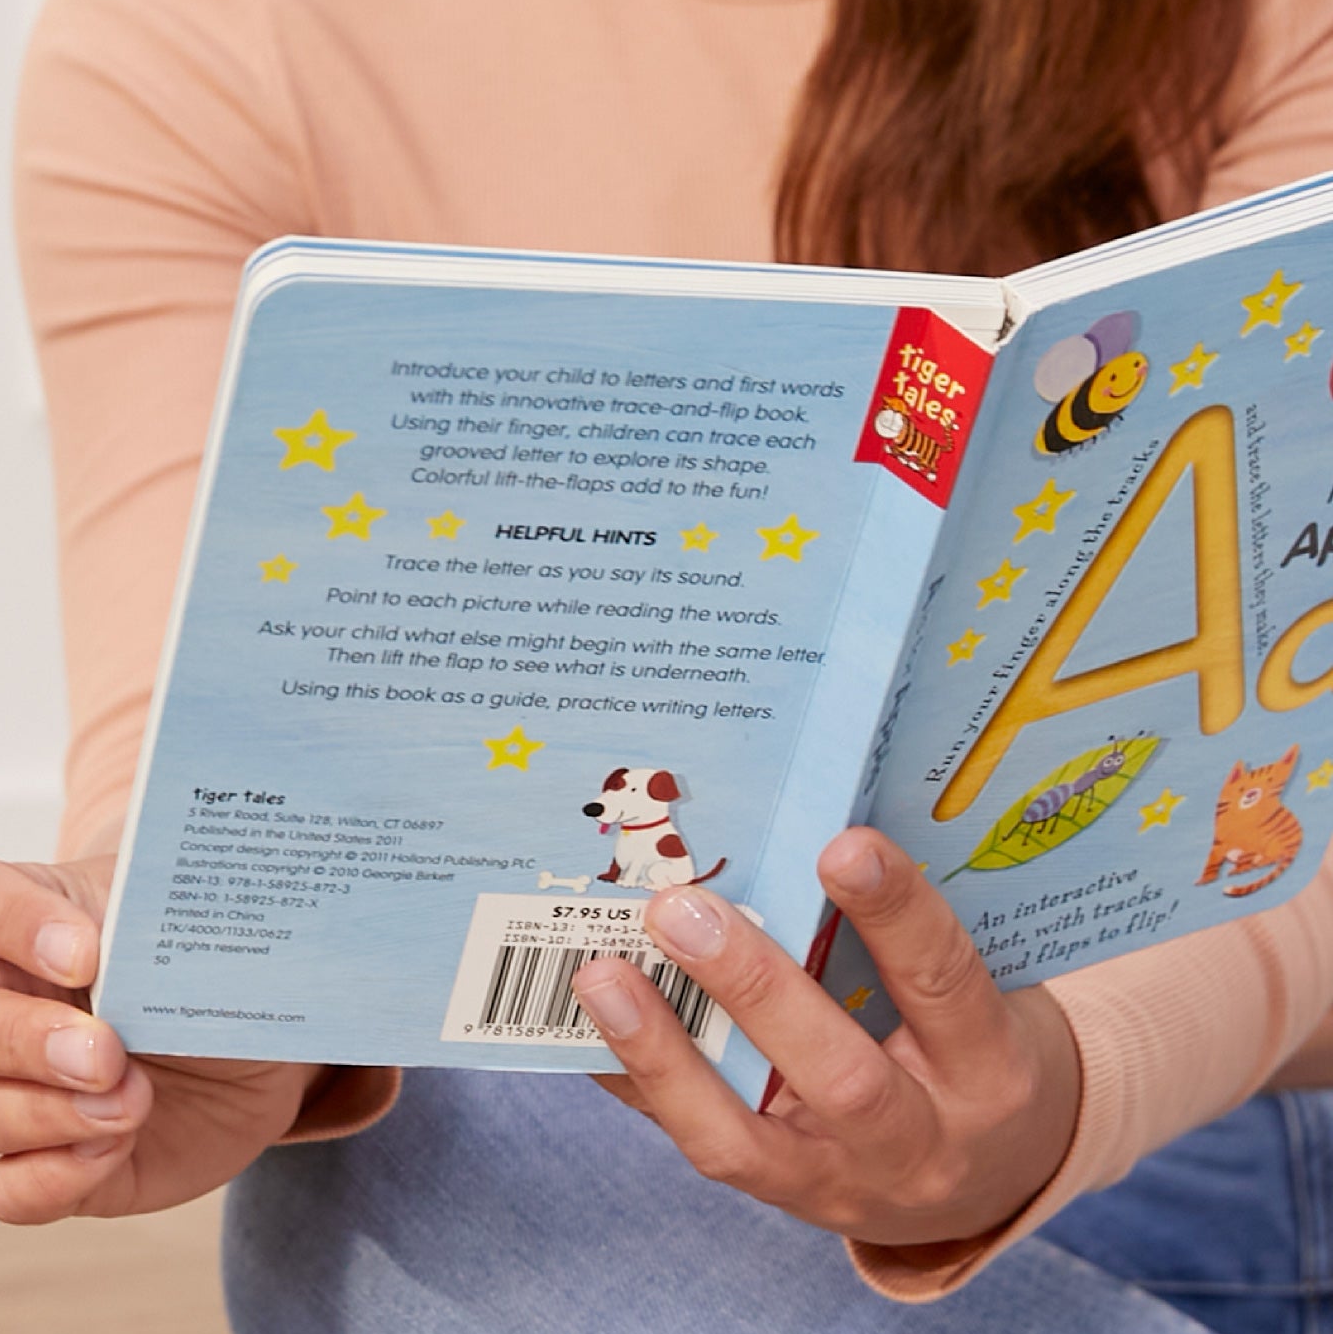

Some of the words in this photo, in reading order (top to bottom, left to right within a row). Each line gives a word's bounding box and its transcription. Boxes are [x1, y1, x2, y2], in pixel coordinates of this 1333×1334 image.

[391, 361, 489, 380] Introduce
[495, 369, 541, 384] your
[546, 368, 596, 385] child
[601, 371, 620, 386] to
[625, 371, 687, 389] letters
[692, 375, 735, 392] and
[740, 376, 776, 394] first
[781, 381, 845, 398] words
[899, 344, 965, 398] tiger
[410, 389, 453, 405] with
[460, 390, 495, 406] this
[500, 392, 606, 412] innovative
[610, 398, 749, 423] trace-and-flip
[754, 404, 809, 423] book.
[893, 371, 956, 426] tales
[391, 414, 451, 435] Using
[457, 416, 503, 433] their
[508, 418, 570, 440] finger,
[578, 423, 660, 441] children
[665, 430, 704, 443] can
[709, 430, 761, 447] trace
[765, 434, 816, 450] each
[420, 445, 508, 461] grooved
[512, 445, 564, 463] letter
[568, 450, 587, 464] to
[593, 451, 670, 469] explore
[675, 454, 698, 470] its
[702, 455, 770, 476] shape.
[411, 468, 490, 486] Colorful
[495, 471, 615, 495] lift-the-flaps
[620, 478, 663, 494] add
[667, 481, 687, 496] to
[692, 481, 724, 497] the
[729, 482, 769, 499] fun!
[494, 524, 586, 543] HELPFUL
[592, 529, 658, 546] HINTS
[386, 554, 440, 572] Trace
[446, 558, 478, 574] the
[483, 559, 534, 576] letter
[538, 566, 563, 578] as
[568, 568, 605, 582] you
[610, 569, 646, 585] say
[650, 568, 673, 583] its
[677, 571, 744, 587] sound.
[326, 588, 377, 604] Point
[382, 592, 401, 606] to
[406, 593, 457, 609] each
[461, 595, 532, 613] picture
[537, 599, 591, 615] while
[596, 602, 674, 623] reading
[680, 604, 711, 621] the
[716, 609, 781, 625] words.
[926, 738, 965, 782] Run
[965, 685, 1000, 734] your
[993, 614, 1045, 679] finger
[1045, 549, 1094, 607] along
[1083, 512, 1113, 546] the
[1108, 438, 1160, 506] tracks
[257, 620, 296, 635] Ask
[302, 625, 346, 640] your
[351, 625, 400, 642] child
[405, 628, 456, 644] what
[460, 630, 502, 647] else
[506, 633, 565, 652] might
[569, 635, 626, 655] begin
[632, 639, 673, 655] with
[679, 641, 710, 657] the
[714, 646, 772, 660] same
[776, 645, 826, 665] letter.
[328, 647, 376, 664] Then
[381, 650, 404, 665] lift
[409, 651, 441, 667] the
[445, 652, 484, 673] flap
[489, 657, 508, 671] to
[513, 660, 549, 673] see
[555, 659, 606, 675] what
[610, 661, 626, 677] is
[631, 664, 750, 683] underneath.
[282, 680, 339, 701] Using
[345, 683, 380, 699] this
[385, 685, 436, 702] book
[441, 692, 466, 703] as
[470, 693, 485, 704] a
[488, 692, 550, 709] guide,
[557, 697, 637, 712] practice
[642, 700, 708, 719] writing
[713, 701, 775, 719] letters.
[193, 788, 237, 805] tiger
[243, 791, 286, 805] tales
[552, 906, 601, 919] $7.95
[607, 909, 632, 920] US
[972, 912, 1005, 934] An
[1014, 869, 1138, 919] interactive
[1036, 907, 1084, 937] with
[1093, 884, 1164, 919] tracks
[1036, 933, 1090, 964] flaps
[1097, 927, 1120, 943] to
[1125, 899, 1180, 934] flip!
